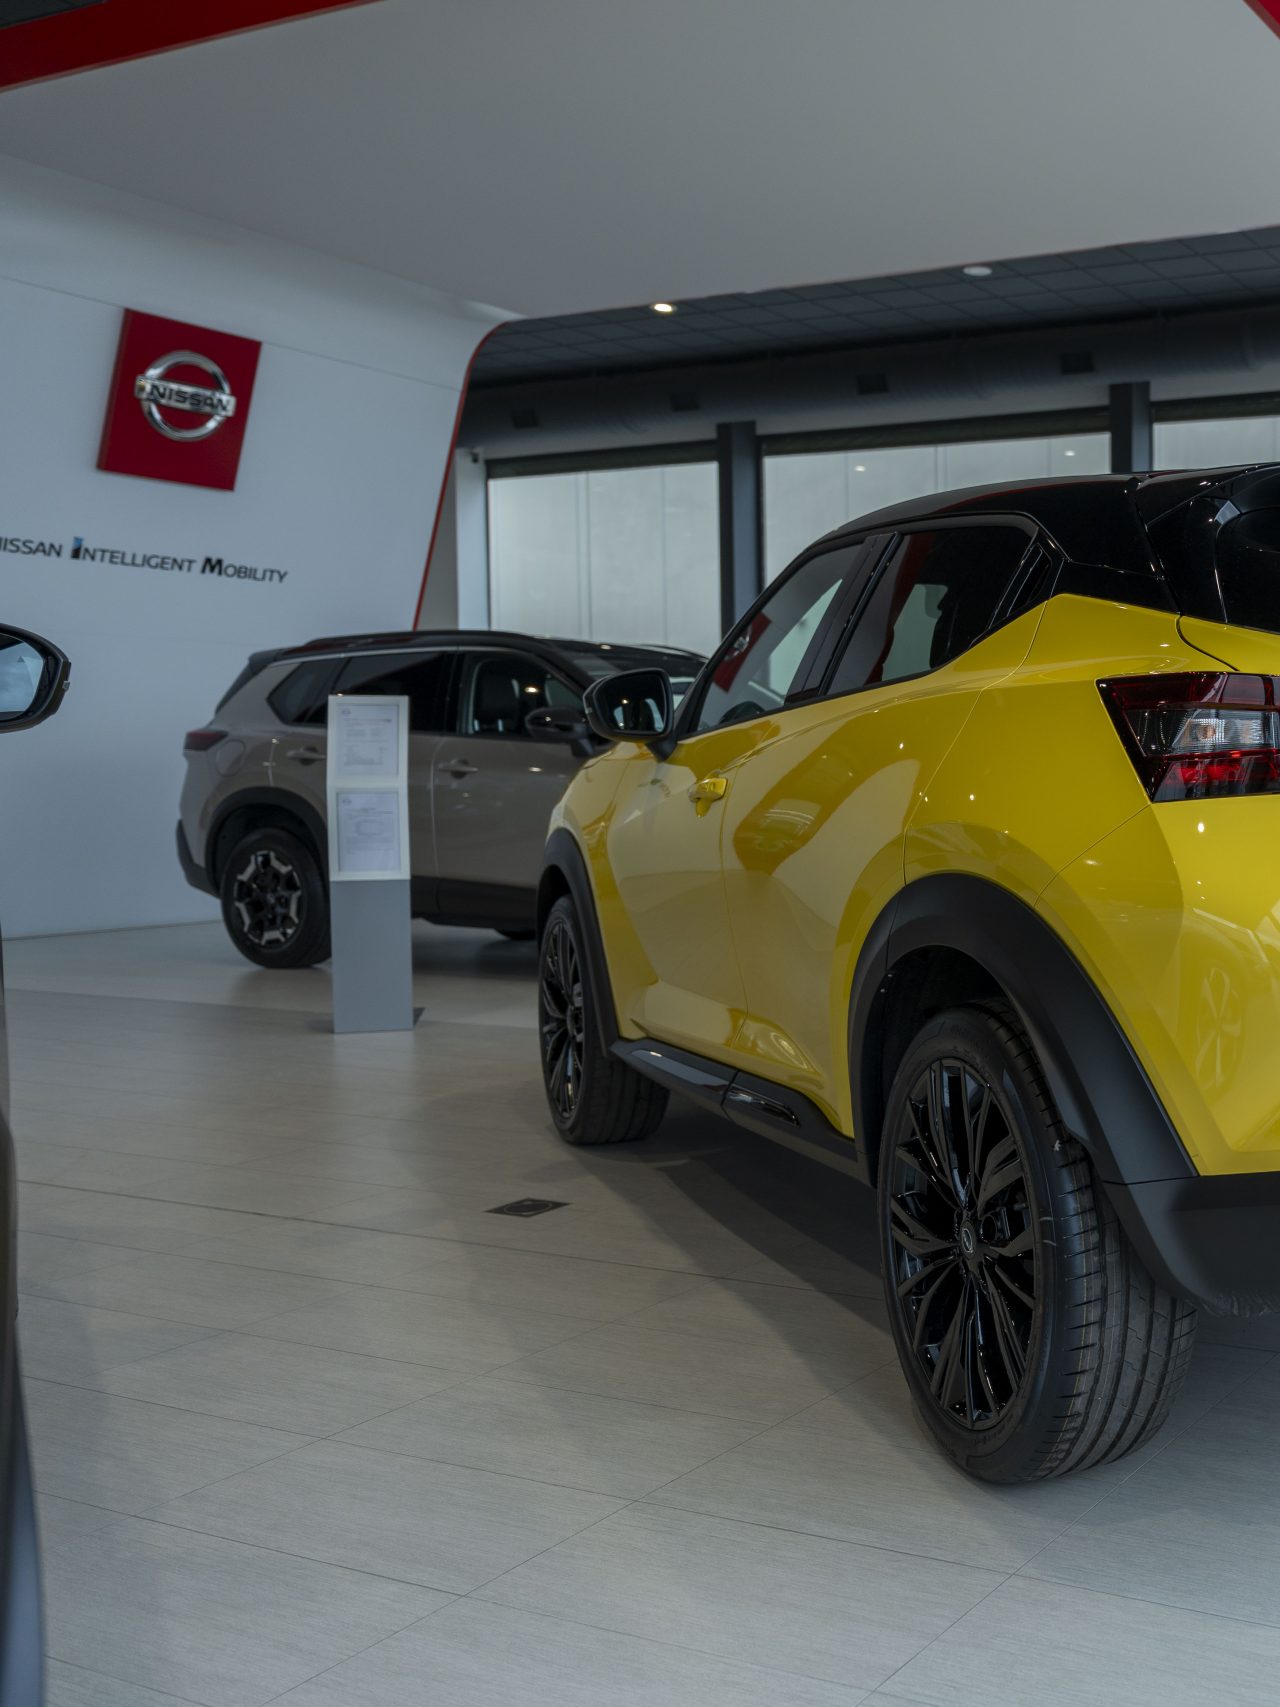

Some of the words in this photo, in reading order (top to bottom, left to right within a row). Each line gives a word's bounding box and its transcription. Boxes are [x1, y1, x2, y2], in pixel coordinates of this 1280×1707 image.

[149, 382, 231, 412] NISSAN
[0, 536, 62, 558] ISSAN
[71, 536, 196, 573] INTELLIGENT
[201, 556, 288, 583] MOBILITY
